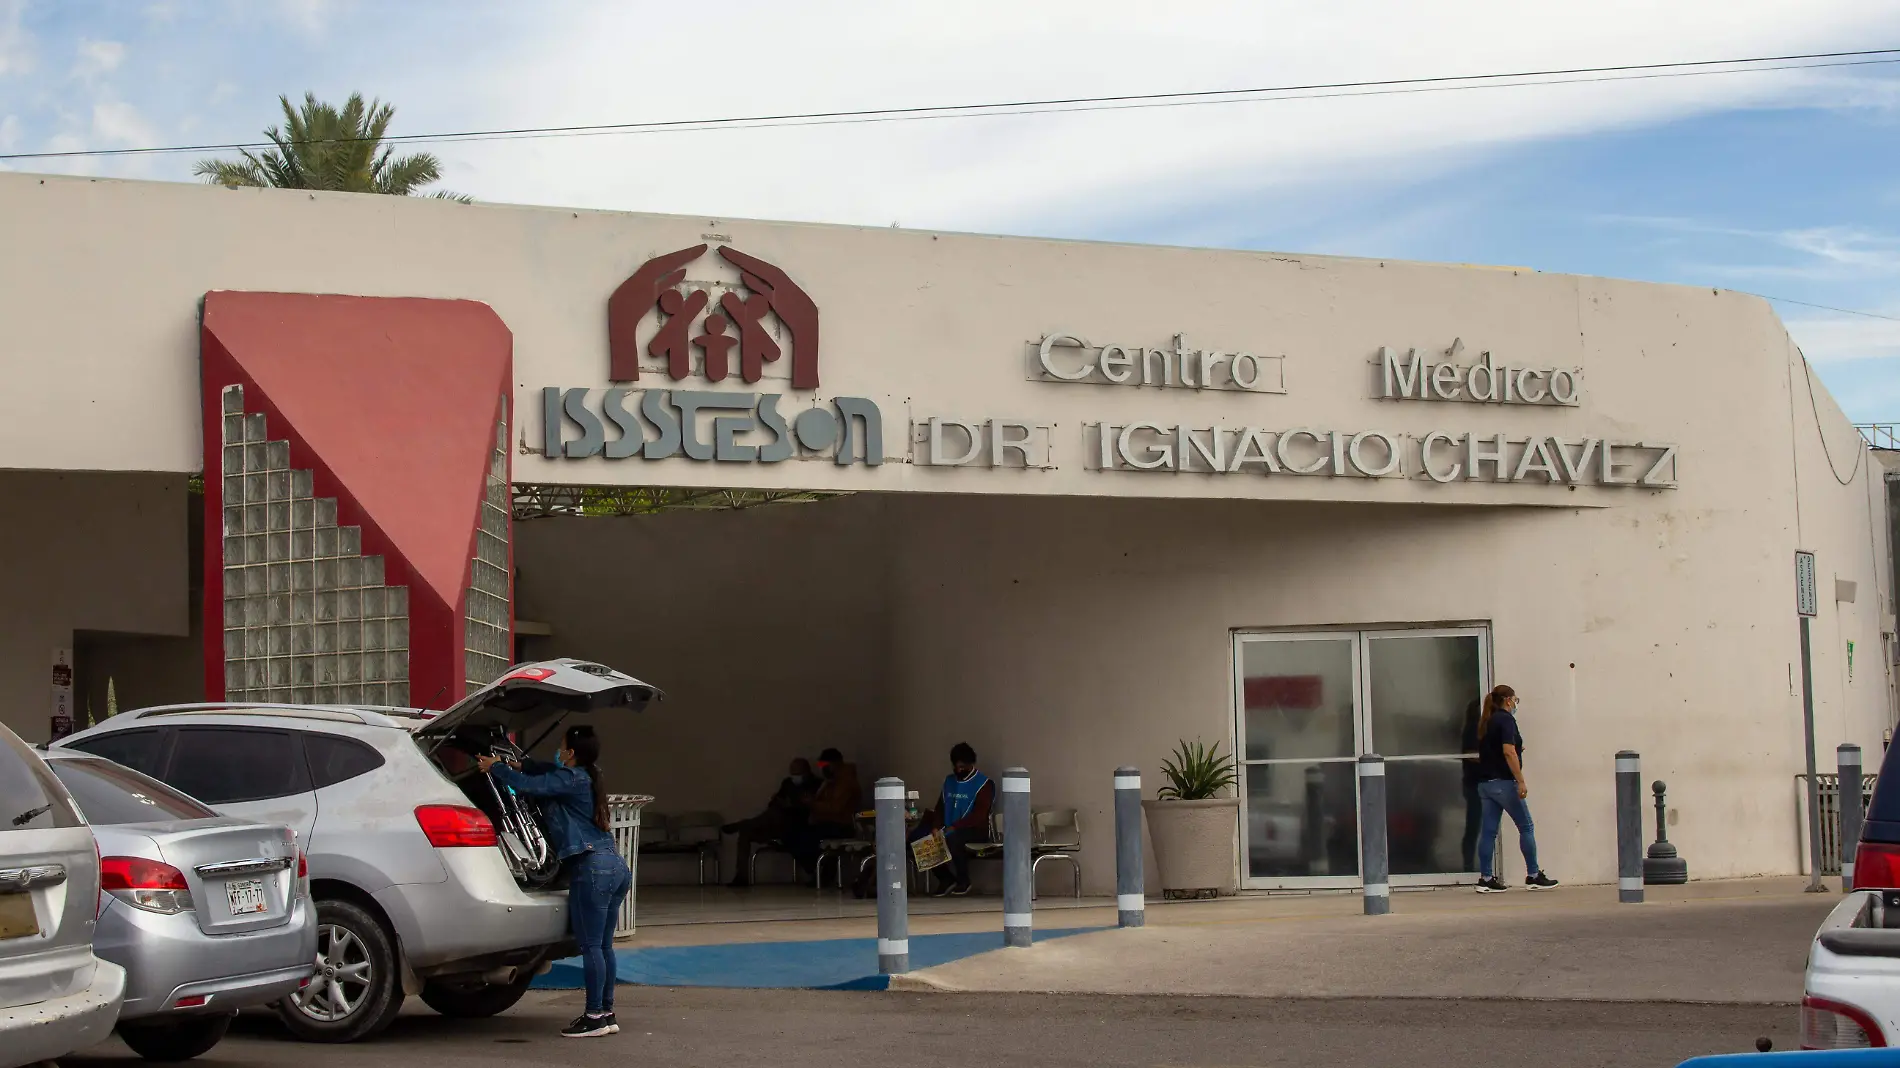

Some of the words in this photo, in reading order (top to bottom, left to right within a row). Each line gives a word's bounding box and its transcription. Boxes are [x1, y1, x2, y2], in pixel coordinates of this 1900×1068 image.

[1038, 331, 1260, 389] Centro
[1379, 336, 1578, 404] Médico
[543, 386, 884, 467] ISSSTESON
[928, 415, 1032, 467] DR
[1098, 420, 1402, 477] IGNACIO
[1419, 430, 1680, 490] CHAVEZ
